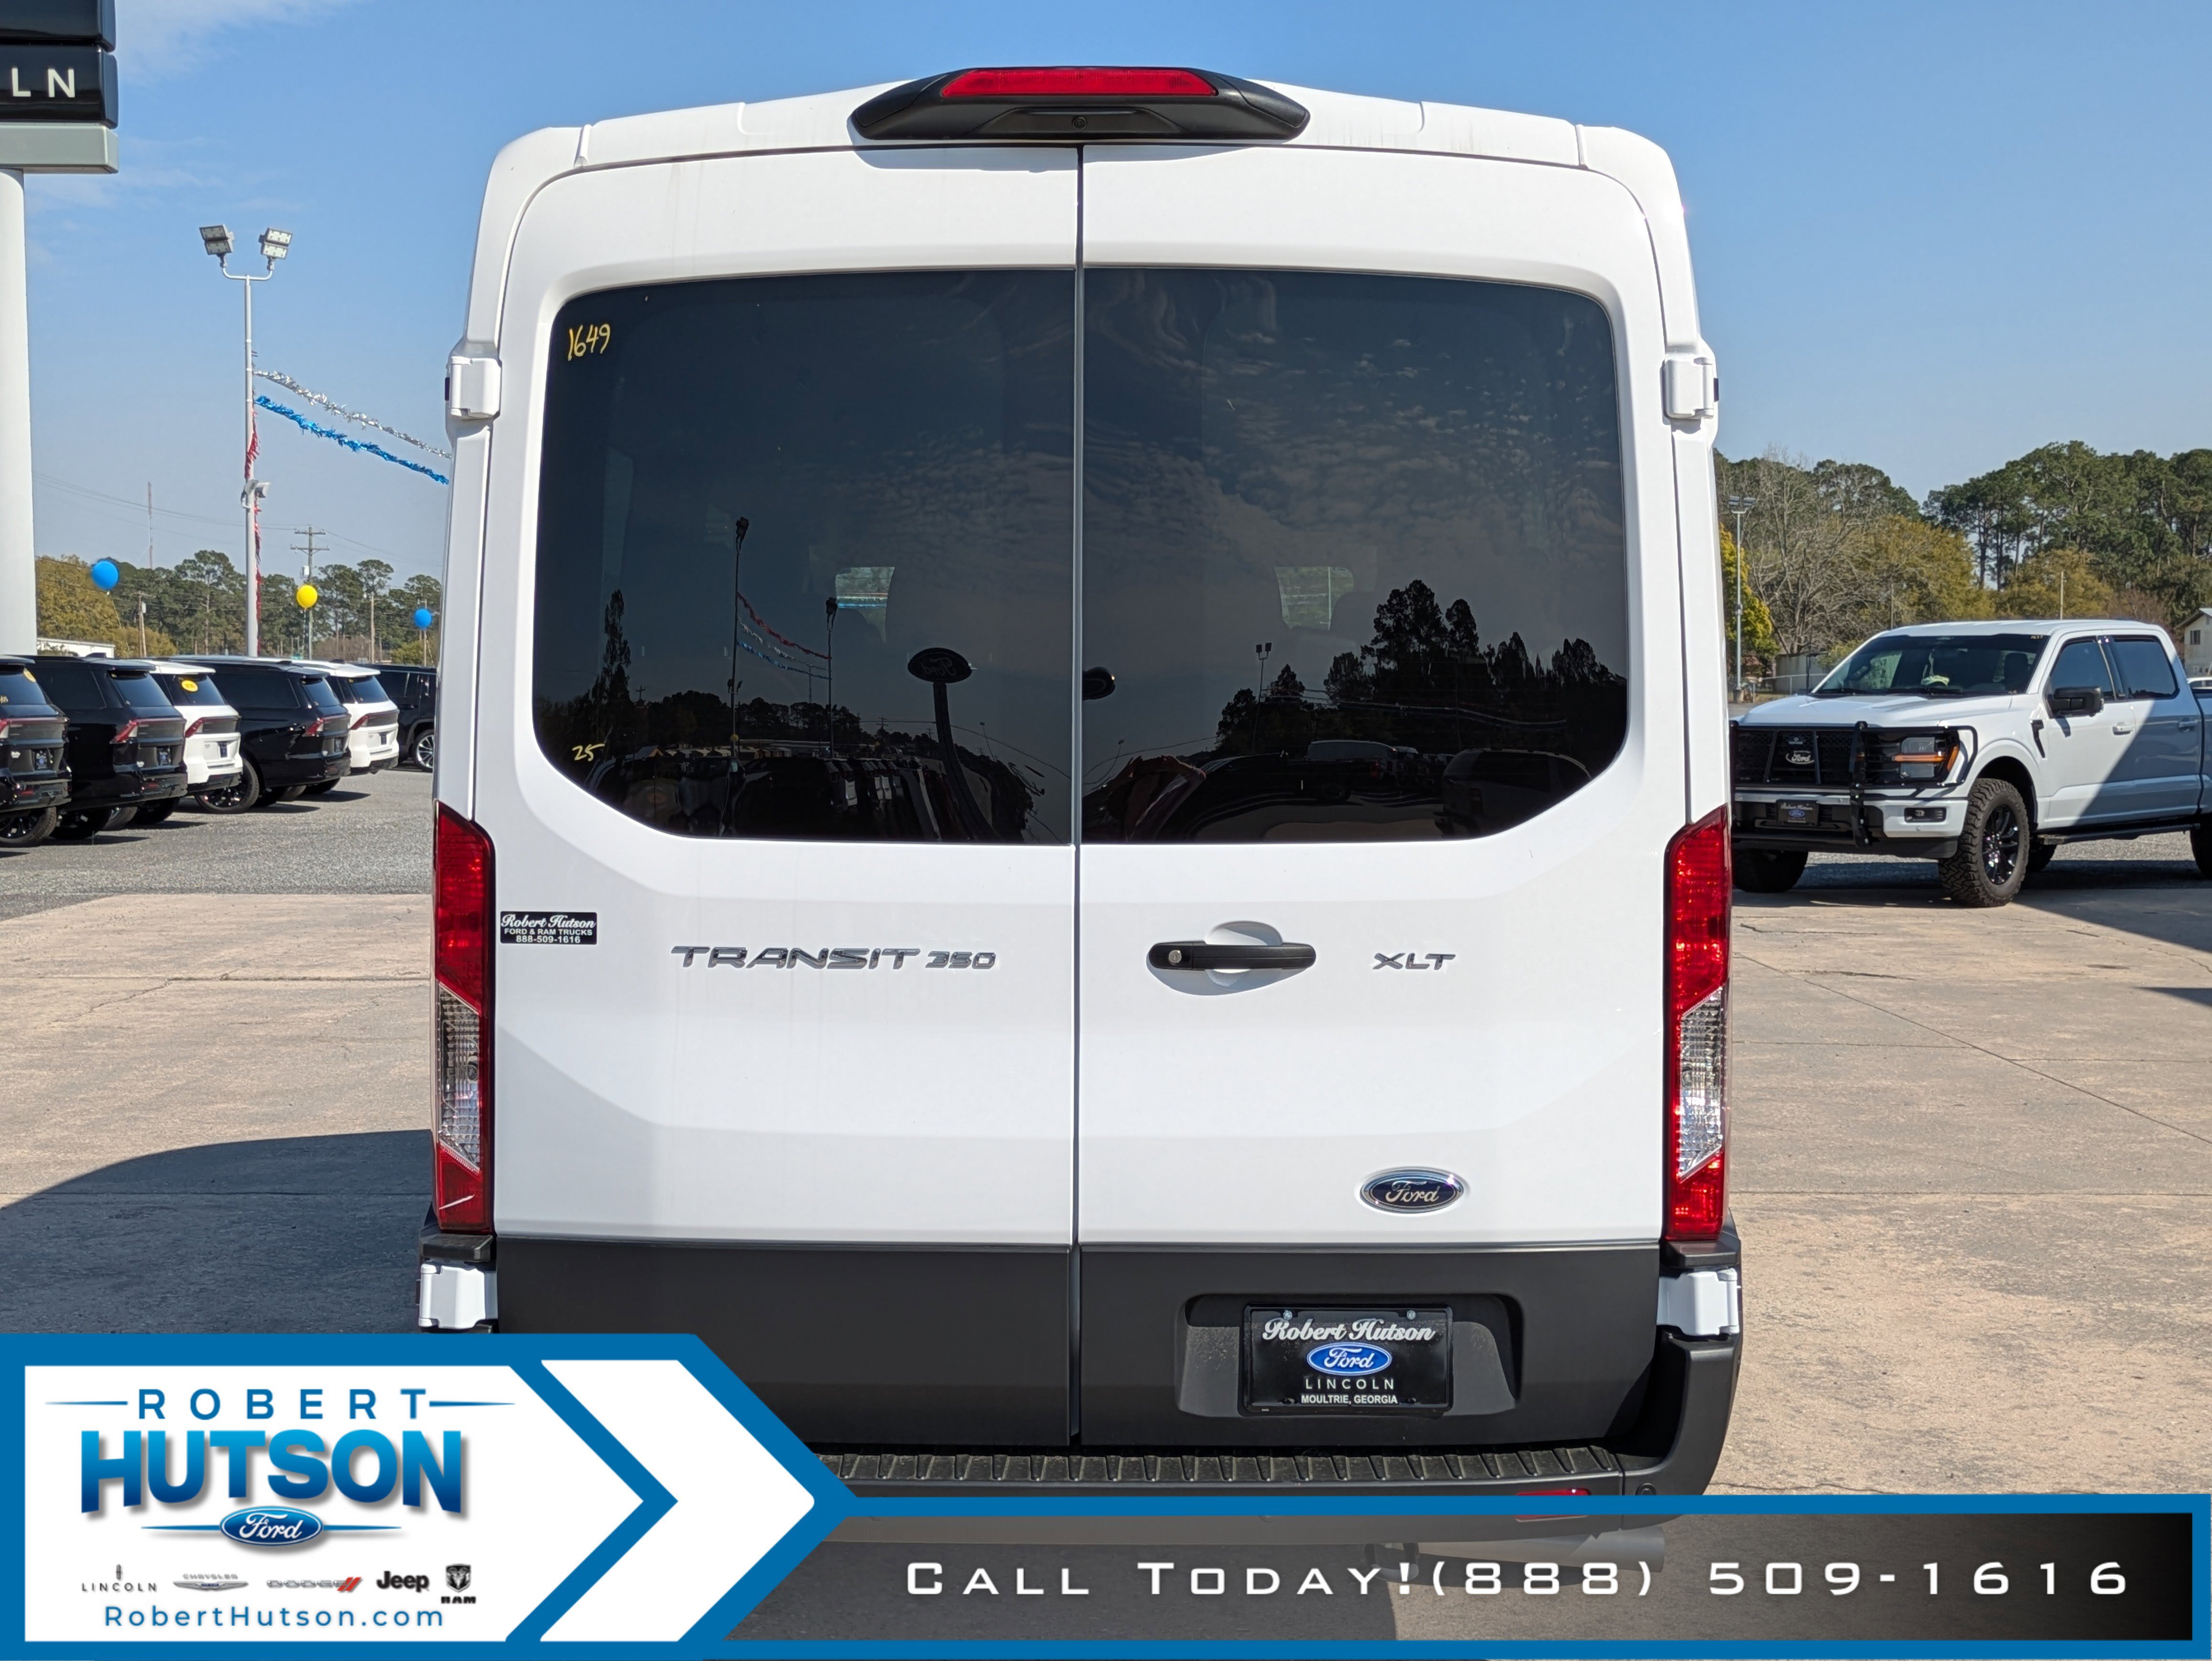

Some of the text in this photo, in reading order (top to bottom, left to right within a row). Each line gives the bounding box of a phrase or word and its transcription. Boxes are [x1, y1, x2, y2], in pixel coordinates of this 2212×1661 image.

[568, 324, 610, 361] 1649
[572, 743, 605, 762] 25
[501, 914, 596, 928] Robert Hutson
[516, 935, 581, 943] 888-509-1616
[671, 946, 996, 970] TRANSIT 350
[1372, 952, 1456, 970] XLT
[1385, 1180, 1440, 1202] Ford
[1262, 1318, 1436, 1341] Robert Hutson
[1324, 1347, 1375, 1368] Ford
[1305, 1379, 1394, 1390] LINCOLN
[1301, 1395, 1398, 1405] MOULTRIE, GEORGIA
